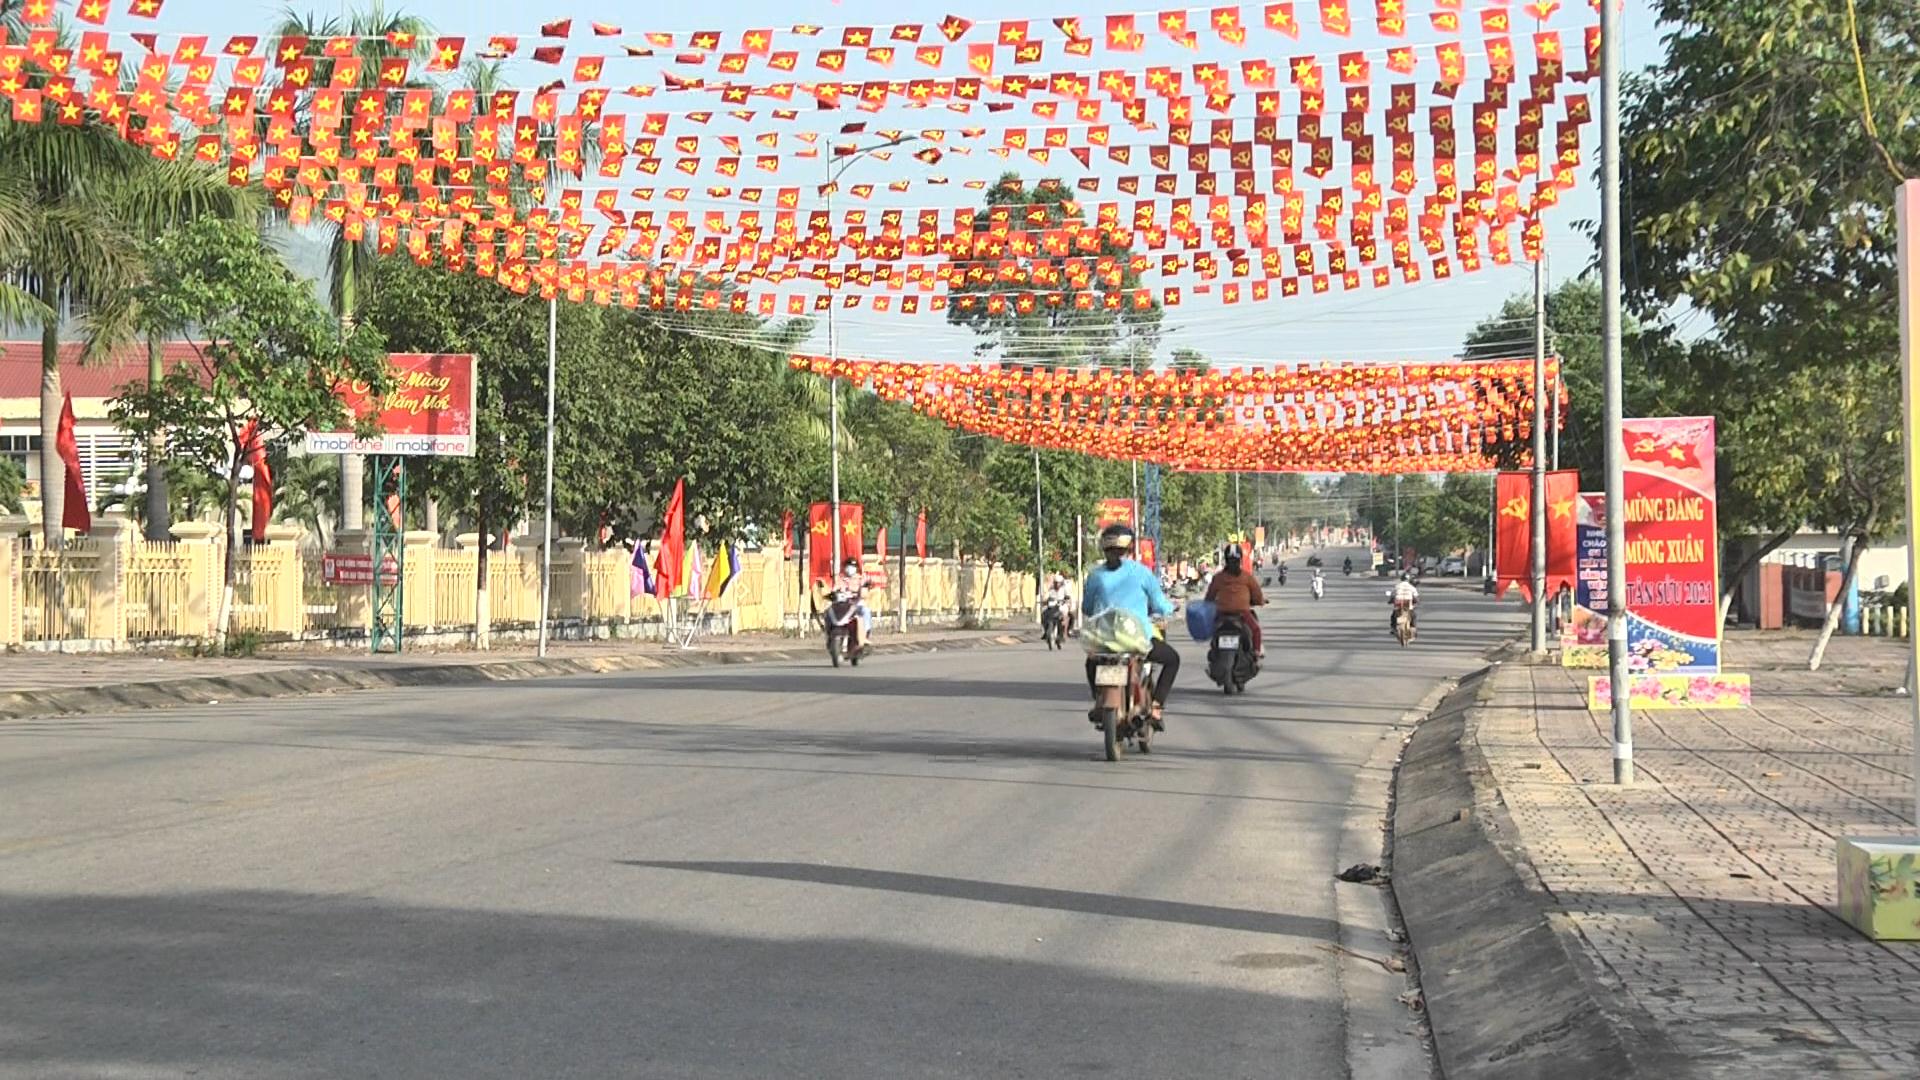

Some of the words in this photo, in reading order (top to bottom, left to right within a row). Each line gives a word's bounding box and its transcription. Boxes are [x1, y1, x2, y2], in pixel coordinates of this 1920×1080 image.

[313, 437, 383, 451] mobifone
[396, 438, 465, 452] mobifone
[1624, 491, 1663, 522] MỪNG
[1665, 490, 1704, 521] ĐẢNG
[1625, 533, 1664, 564] MỪNG
[1666, 533, 1704, 563] XUÂN
[1626, 575, 1654, 606] TÂN
[1656, 573, 1683, 606] SỬU
[1684, 580, 1713, 606] 2021
